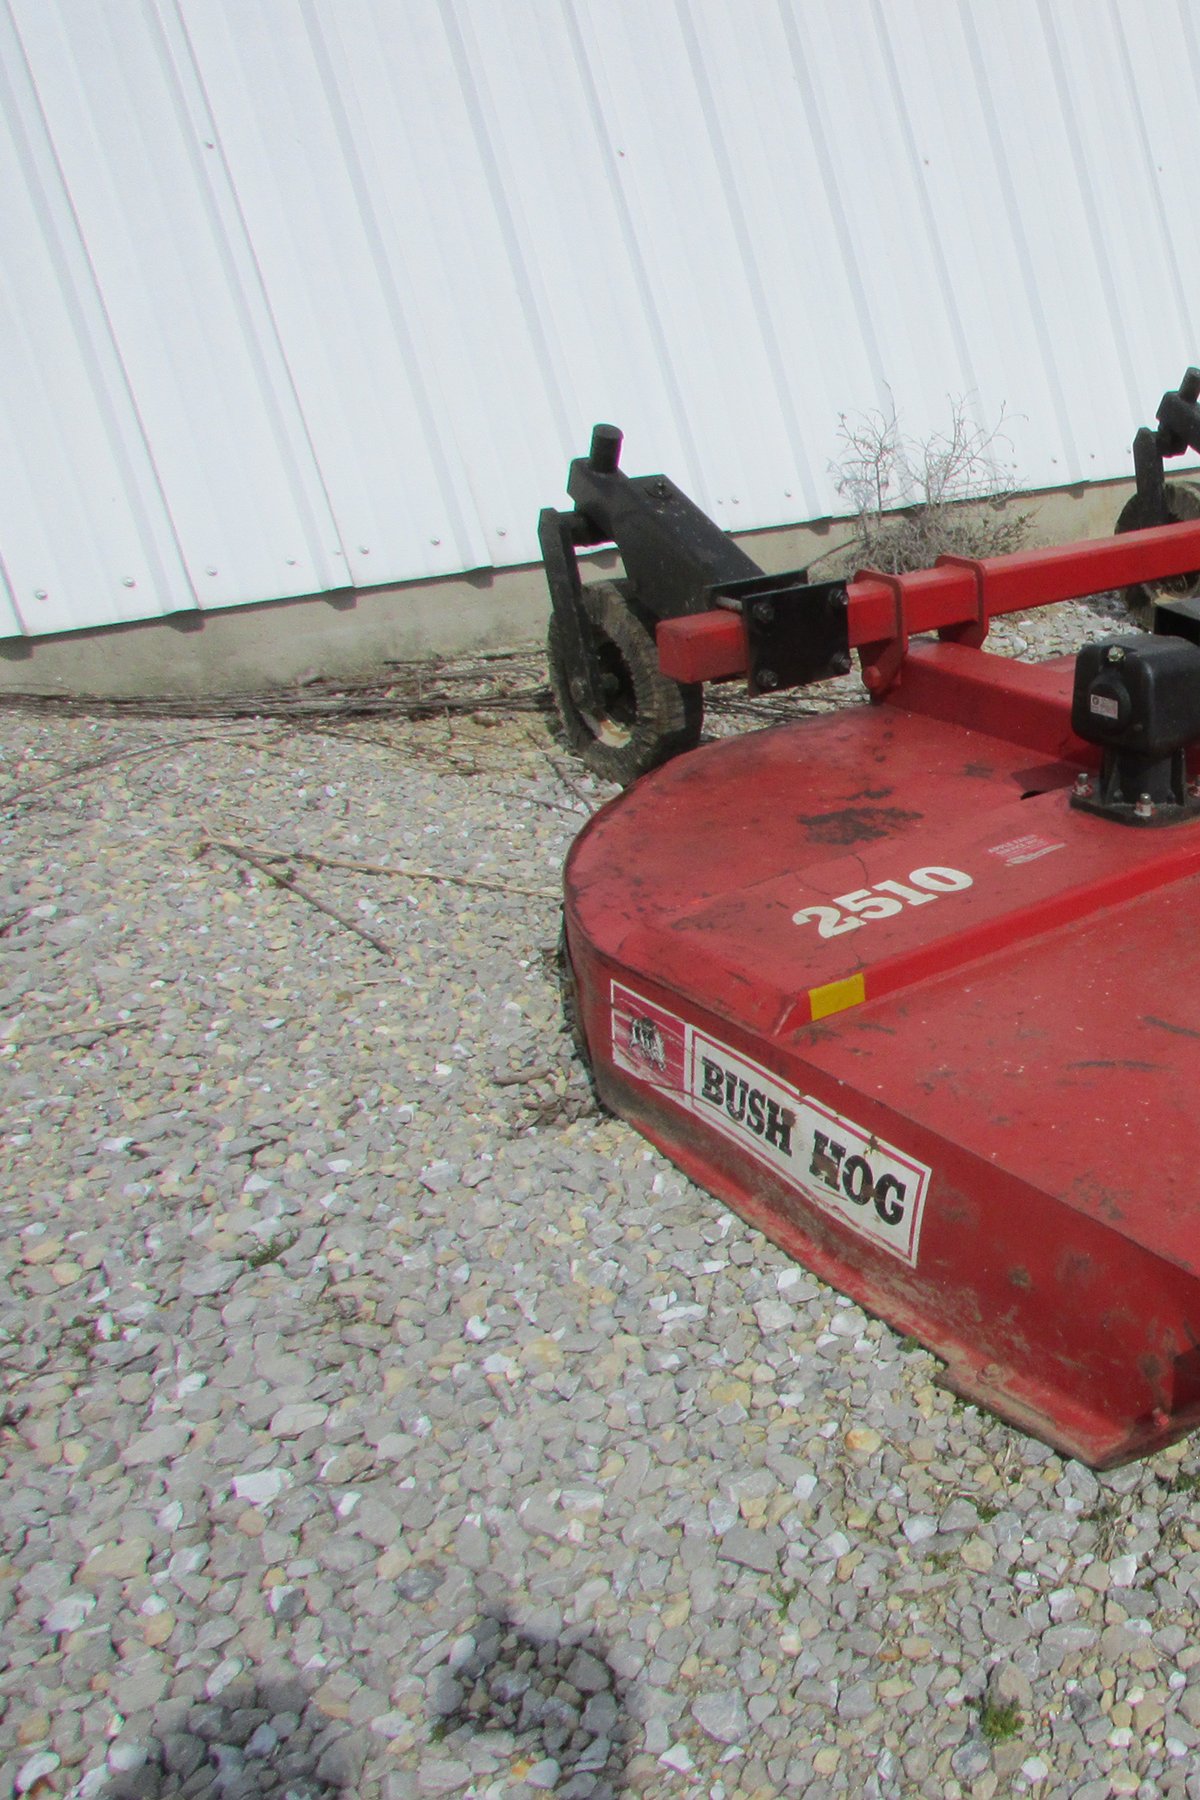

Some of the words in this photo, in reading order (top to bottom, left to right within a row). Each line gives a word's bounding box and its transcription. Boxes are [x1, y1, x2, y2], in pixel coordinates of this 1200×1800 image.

[792, 866, 974, 938] 2510
[701, 1056, 796, 1157] BUSH
[809, 1129, 907, 1226] HOG
